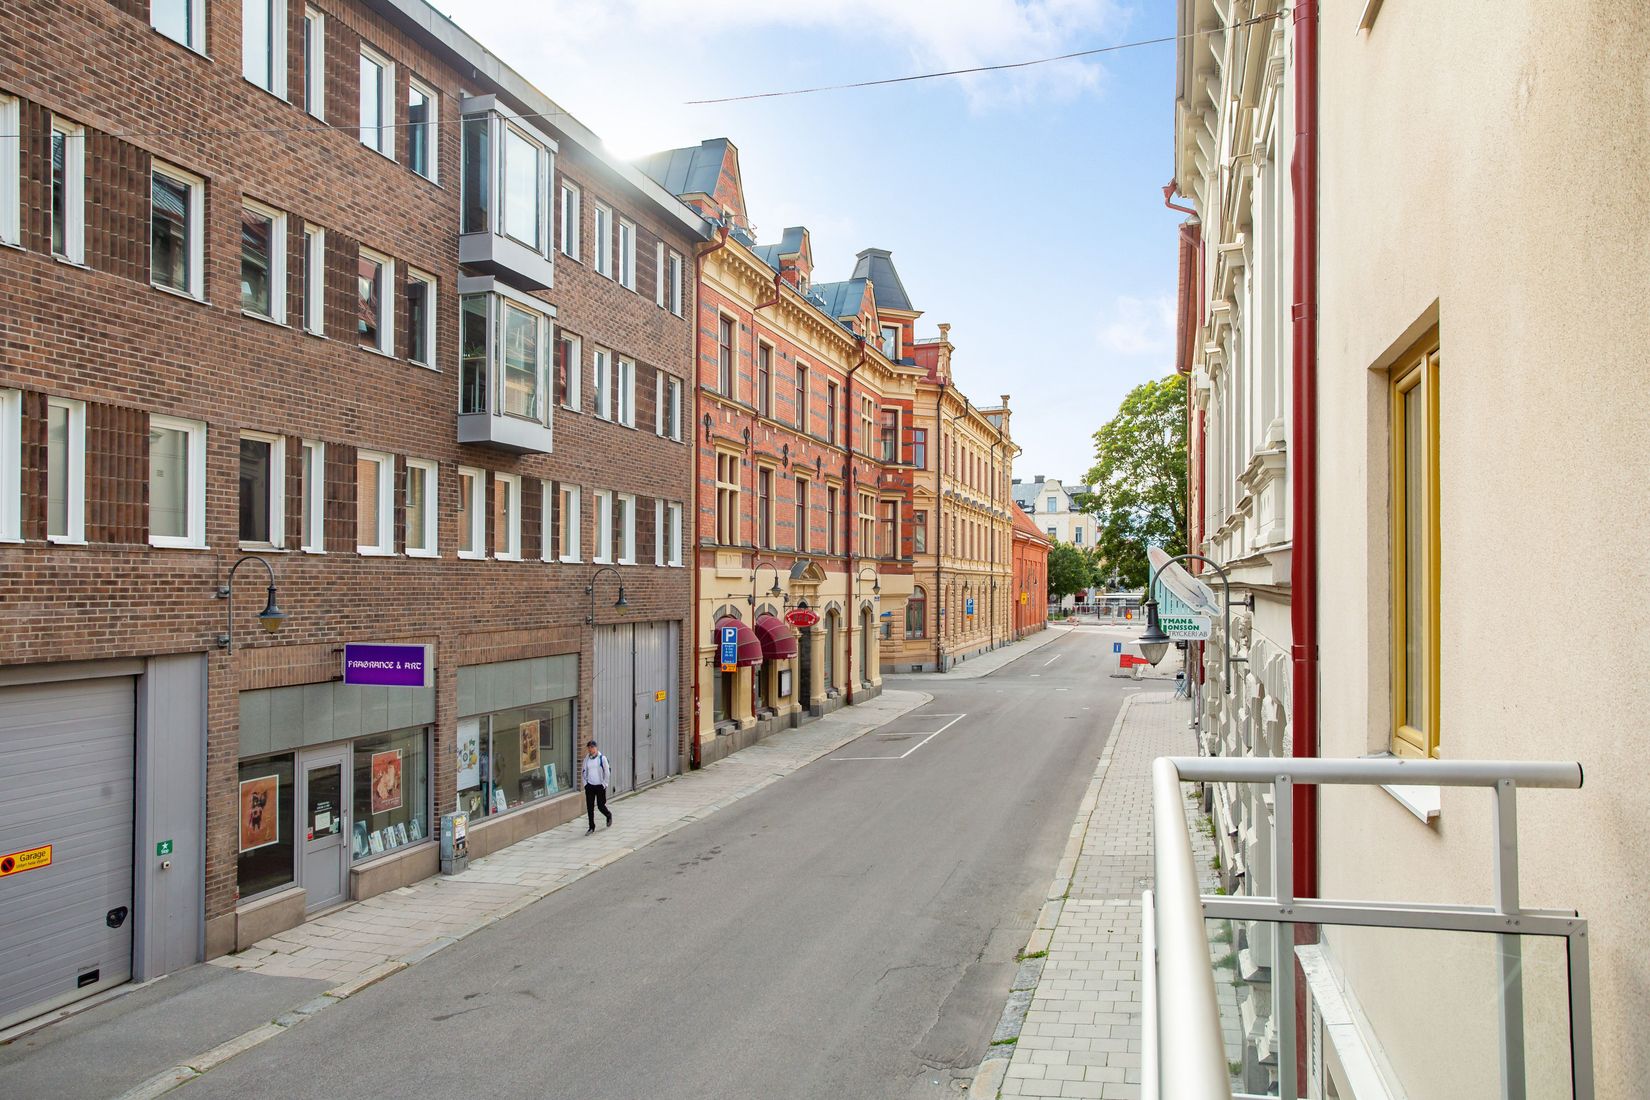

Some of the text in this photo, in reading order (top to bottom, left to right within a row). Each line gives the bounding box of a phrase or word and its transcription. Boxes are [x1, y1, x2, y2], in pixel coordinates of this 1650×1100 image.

[725, 628, 735, 642] P
[348, 660, 422, 670] FRAGRANCE & ART
[19, 850, 46, 862] Garage
